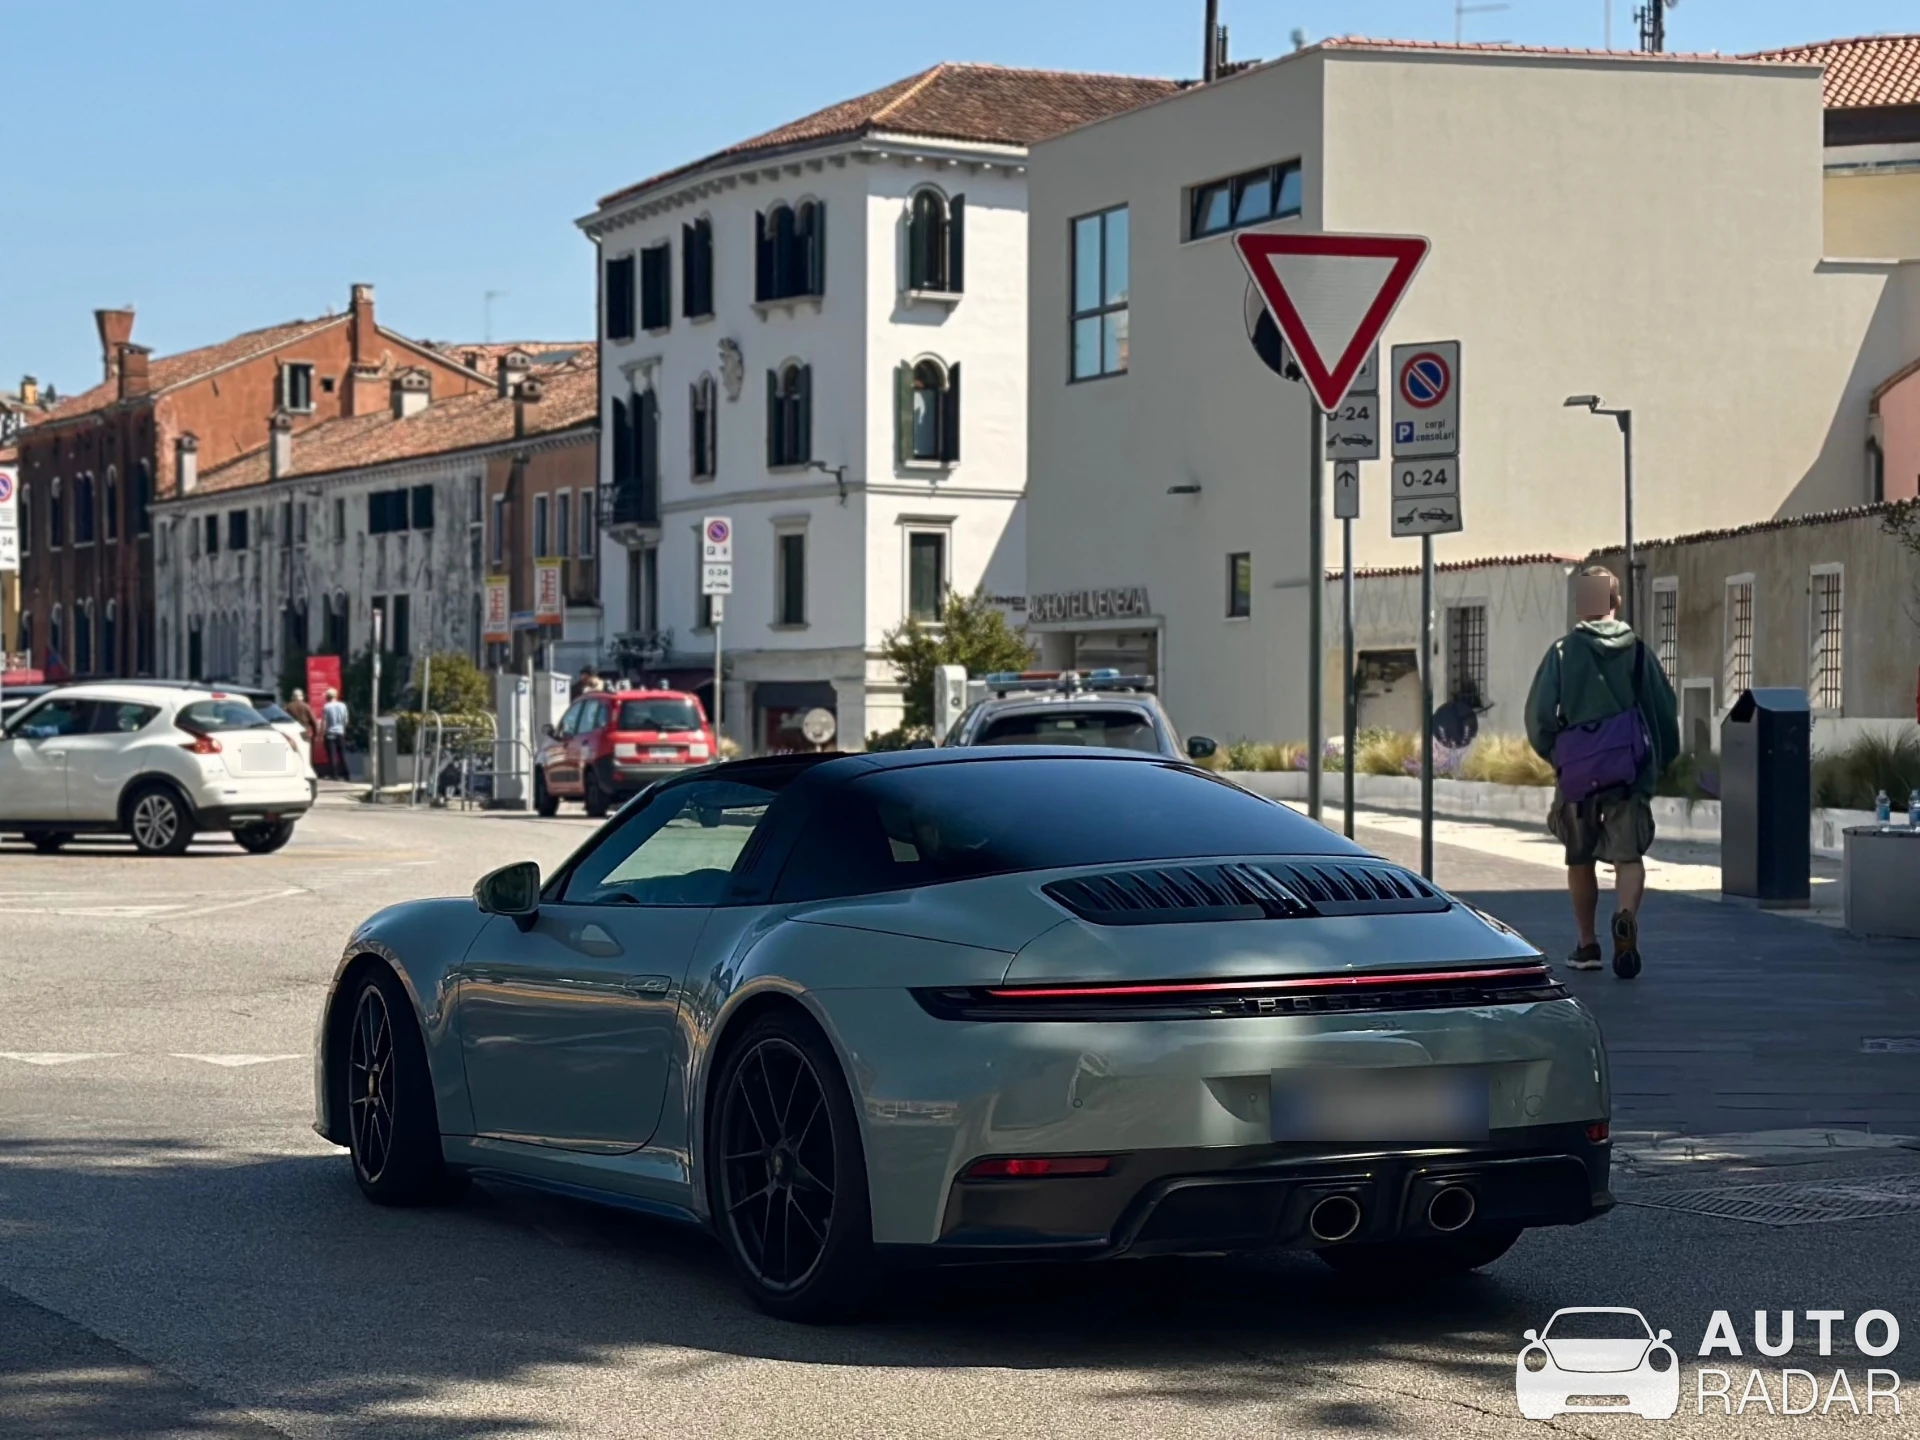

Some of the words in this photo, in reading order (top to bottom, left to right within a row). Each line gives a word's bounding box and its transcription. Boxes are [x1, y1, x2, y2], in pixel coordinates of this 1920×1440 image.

[1424, 419, 1445, 429] corpi
[1416, 429, 1454, 441] consolari
[1402, 468, 1447, 487] 0-24
[1047, 590, 1087, 619] HOTEL
[1089, 586, 1147, 616] VENEZIA
